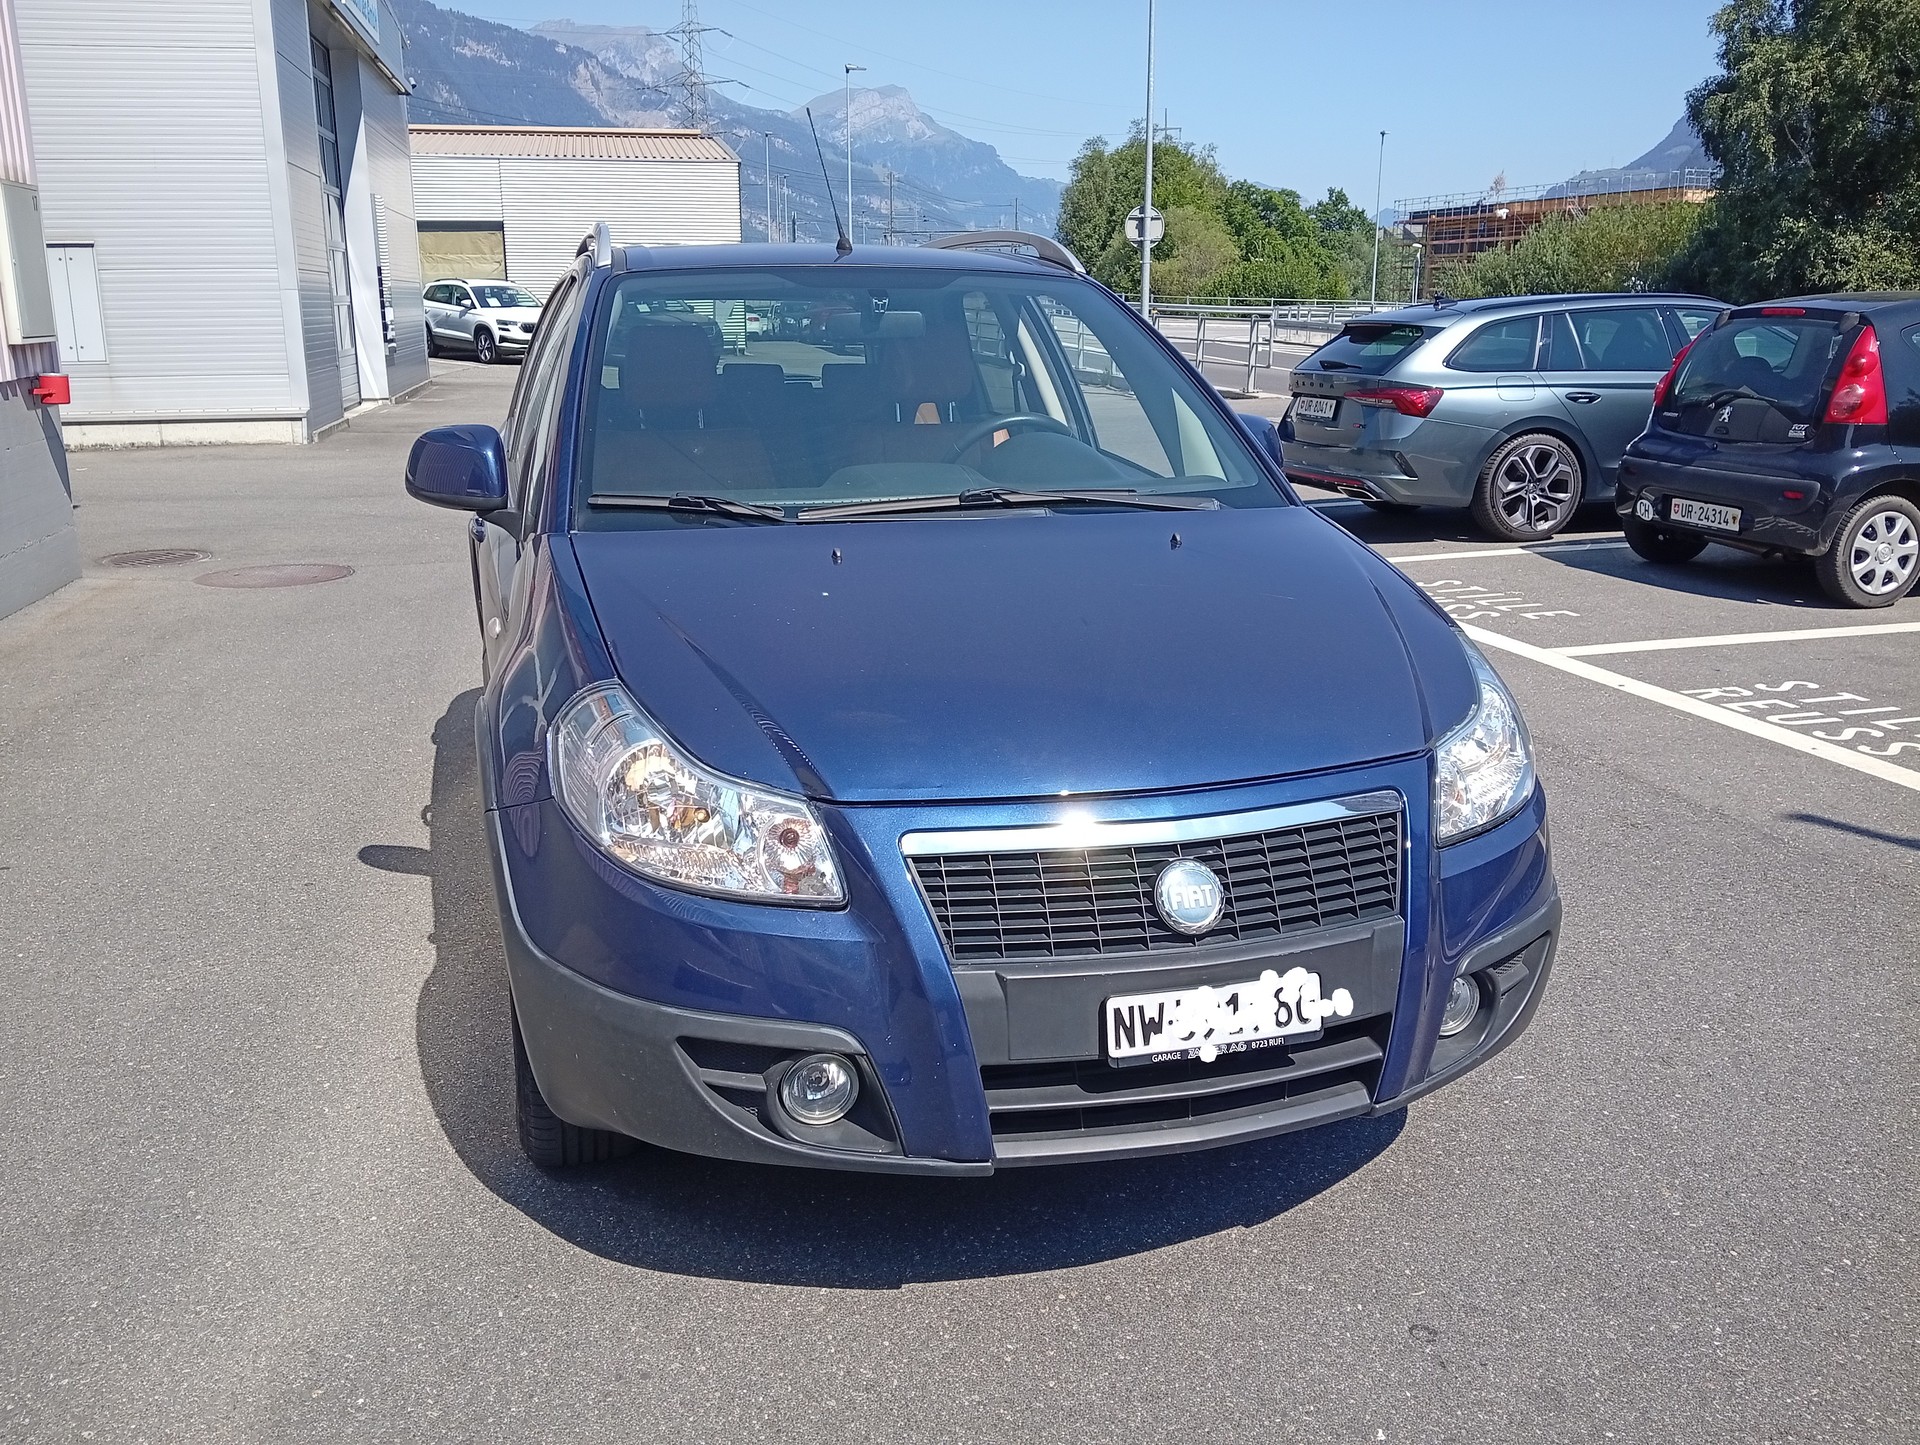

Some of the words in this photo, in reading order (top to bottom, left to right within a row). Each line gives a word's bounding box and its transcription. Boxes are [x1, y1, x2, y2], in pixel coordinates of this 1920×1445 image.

[1639, 501, 1650, 519] CH
[1416, 579, 1580, 620] STILLE
[1679, 686, 1920, 756] REUSS
[1754, 680, 1920, 738] STIL
[1169, 883, 1213, 911] FIAT
[1151, 1052, 1182, 1063] GARAGE
[1229, 1041, 1248, 1054] AG
[1251, 1039, 1268, 1049] 8723
[1269, 1037, 1285, 1047] RUFI
